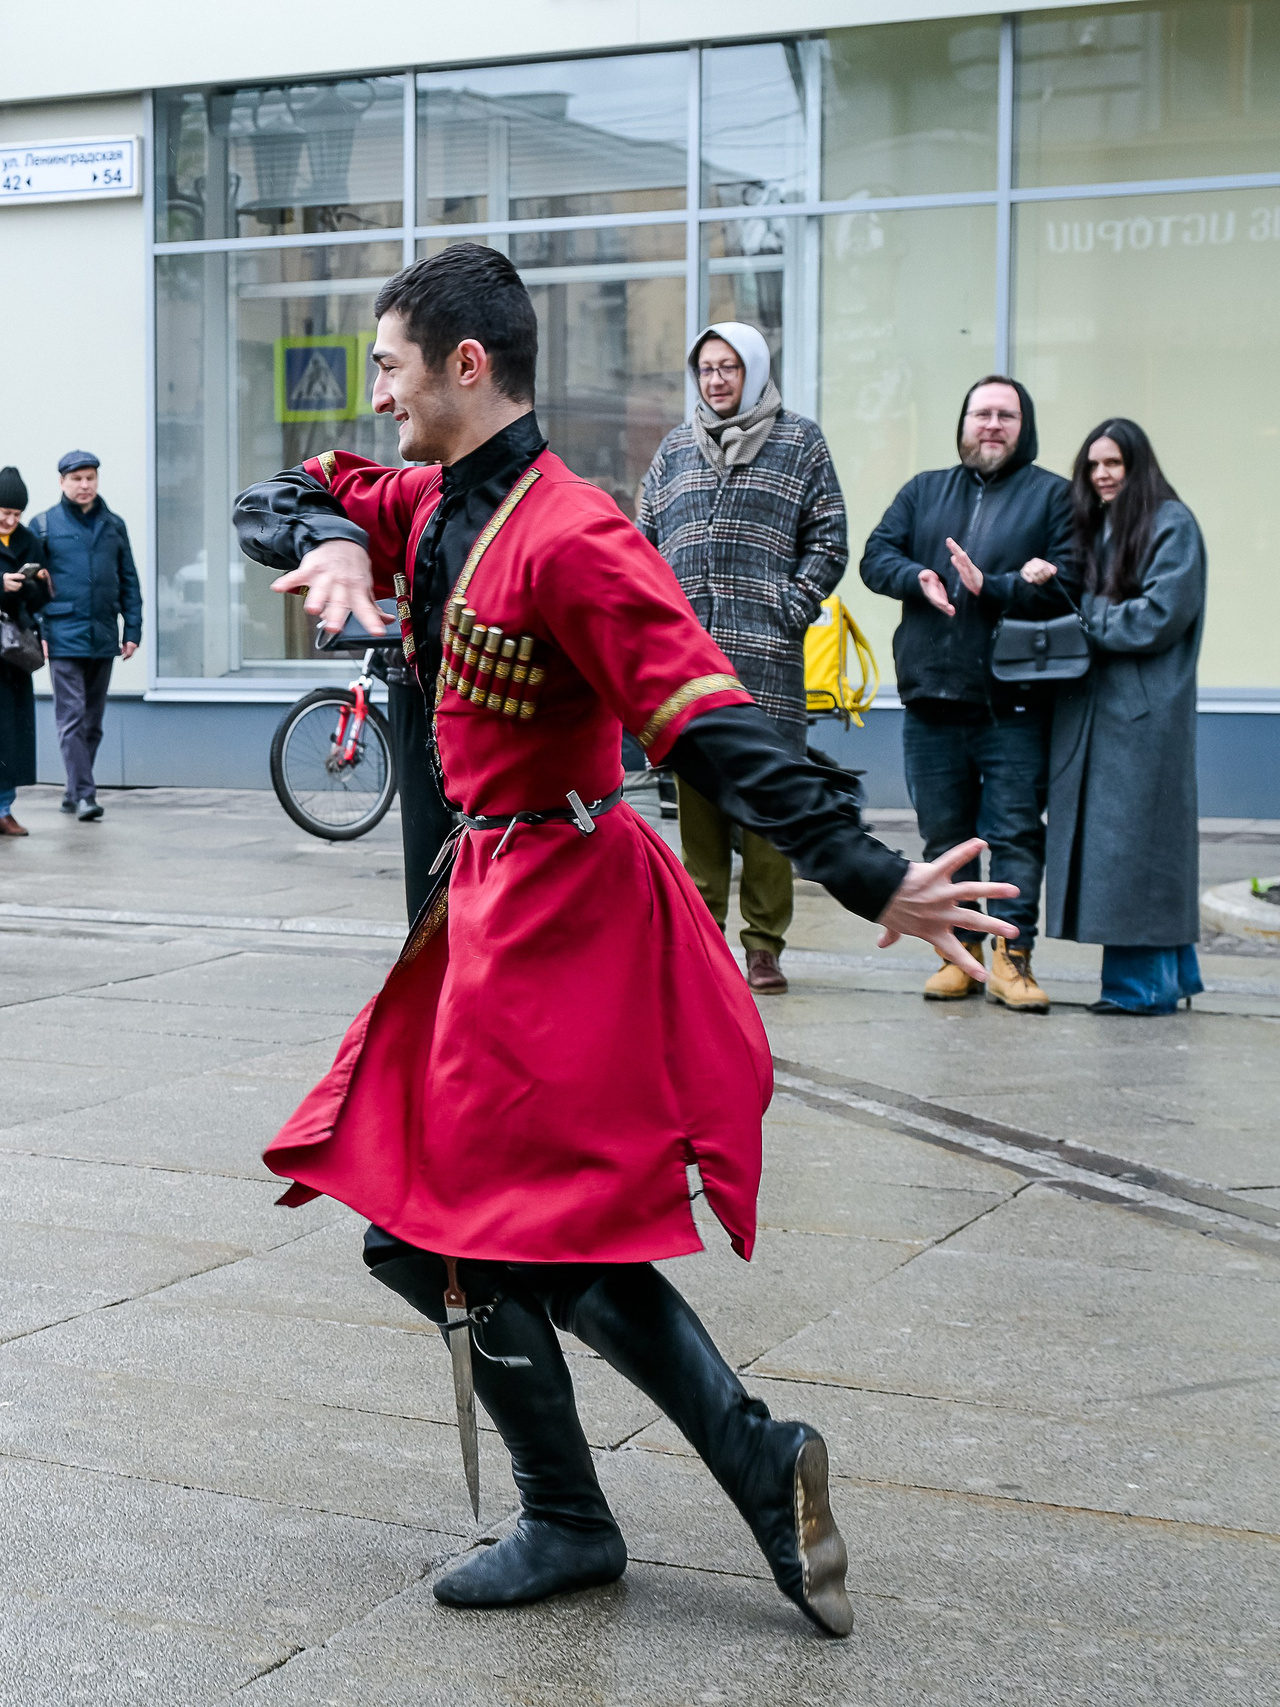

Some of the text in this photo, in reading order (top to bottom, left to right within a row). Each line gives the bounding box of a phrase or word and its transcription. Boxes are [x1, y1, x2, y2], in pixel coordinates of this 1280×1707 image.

[2, 150, 123, 172] ул. Ленинградская
[3, 169, 122, 190] 42 54
